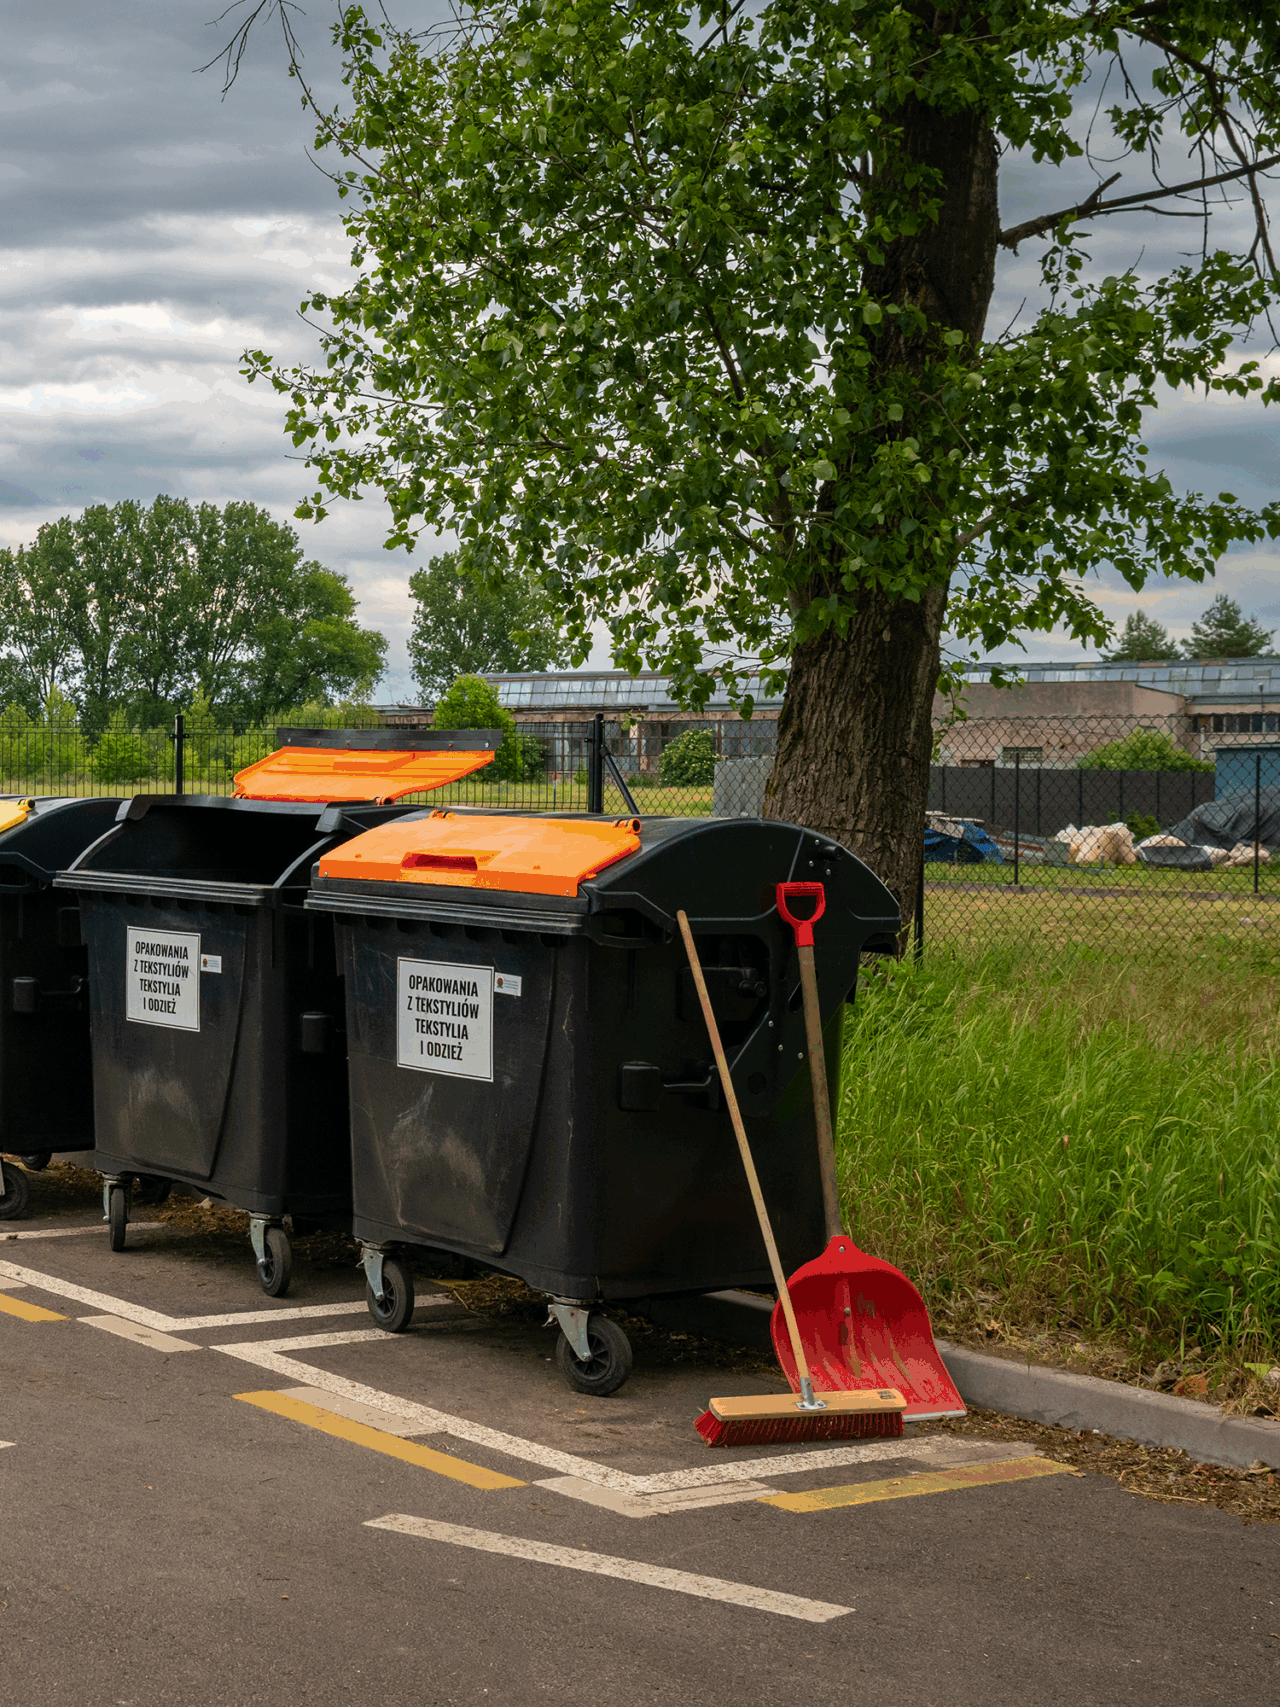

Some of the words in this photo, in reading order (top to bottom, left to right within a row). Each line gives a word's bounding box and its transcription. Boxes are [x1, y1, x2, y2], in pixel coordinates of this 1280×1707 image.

[135, 941, 189, 960] OPAKOWANIA
[134, 959, 138, 972] Z
[140, 960, 189, 979] TEKSTYLIÓW
[140, 978, 181, 997] TEKSTYLIA
[409, 974, 478, 997] OPAKOWANIA
[148, 998, 176, 1014] ODZIEŻ
[407, 996, 413, 1011] Z
[415, 996, 479, 1019] TEKSTYLIÓW
[415, 1018, 469, 1040] TEKSTYLIA
[420, 1040, 424, 1055] I
[427, 1041, 463, 1061] ODZIEŻ
